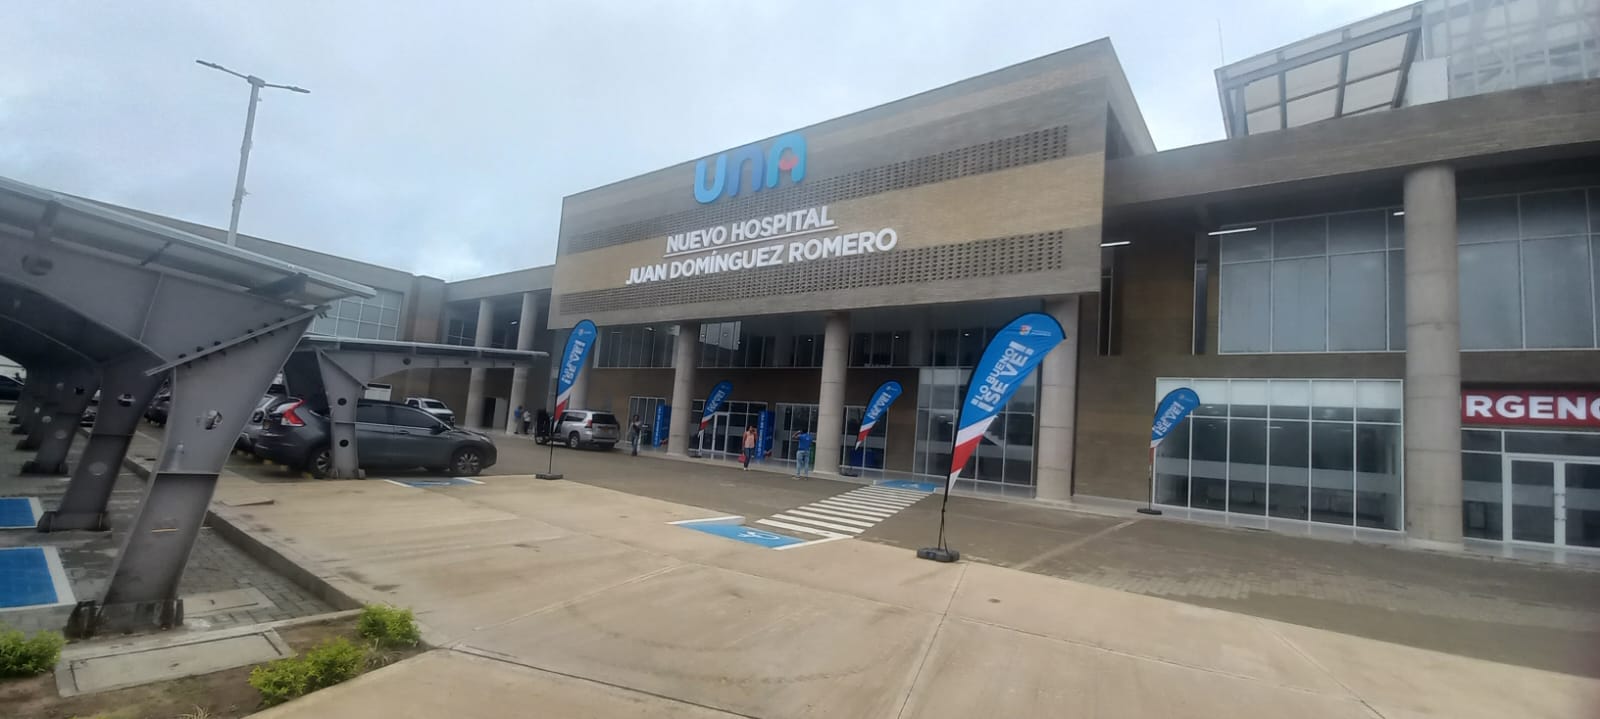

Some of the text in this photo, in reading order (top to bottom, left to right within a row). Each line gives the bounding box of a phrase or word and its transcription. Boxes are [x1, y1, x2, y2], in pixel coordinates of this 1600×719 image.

[694, 132, 807, 204] UNA
[626, 228, 897, 285] JUAN DOMÍNGUEZ ROMERO
[666, 206, 835, 253] NUEVO HOSPITAL
